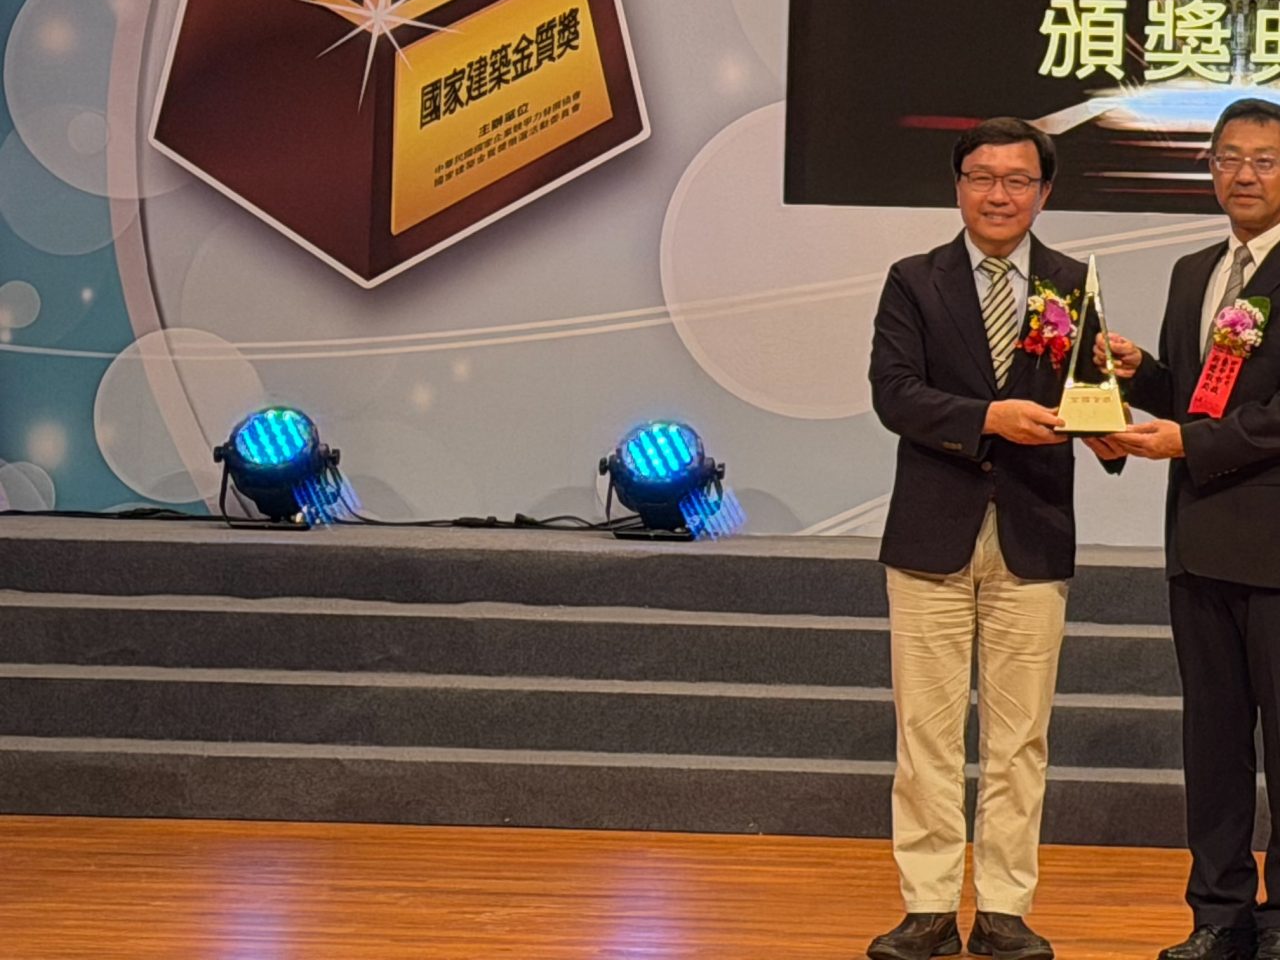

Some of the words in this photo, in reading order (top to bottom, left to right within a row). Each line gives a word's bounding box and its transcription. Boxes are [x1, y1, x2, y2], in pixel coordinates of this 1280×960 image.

[419, 6, 580, 130] 國家建築金質獎
